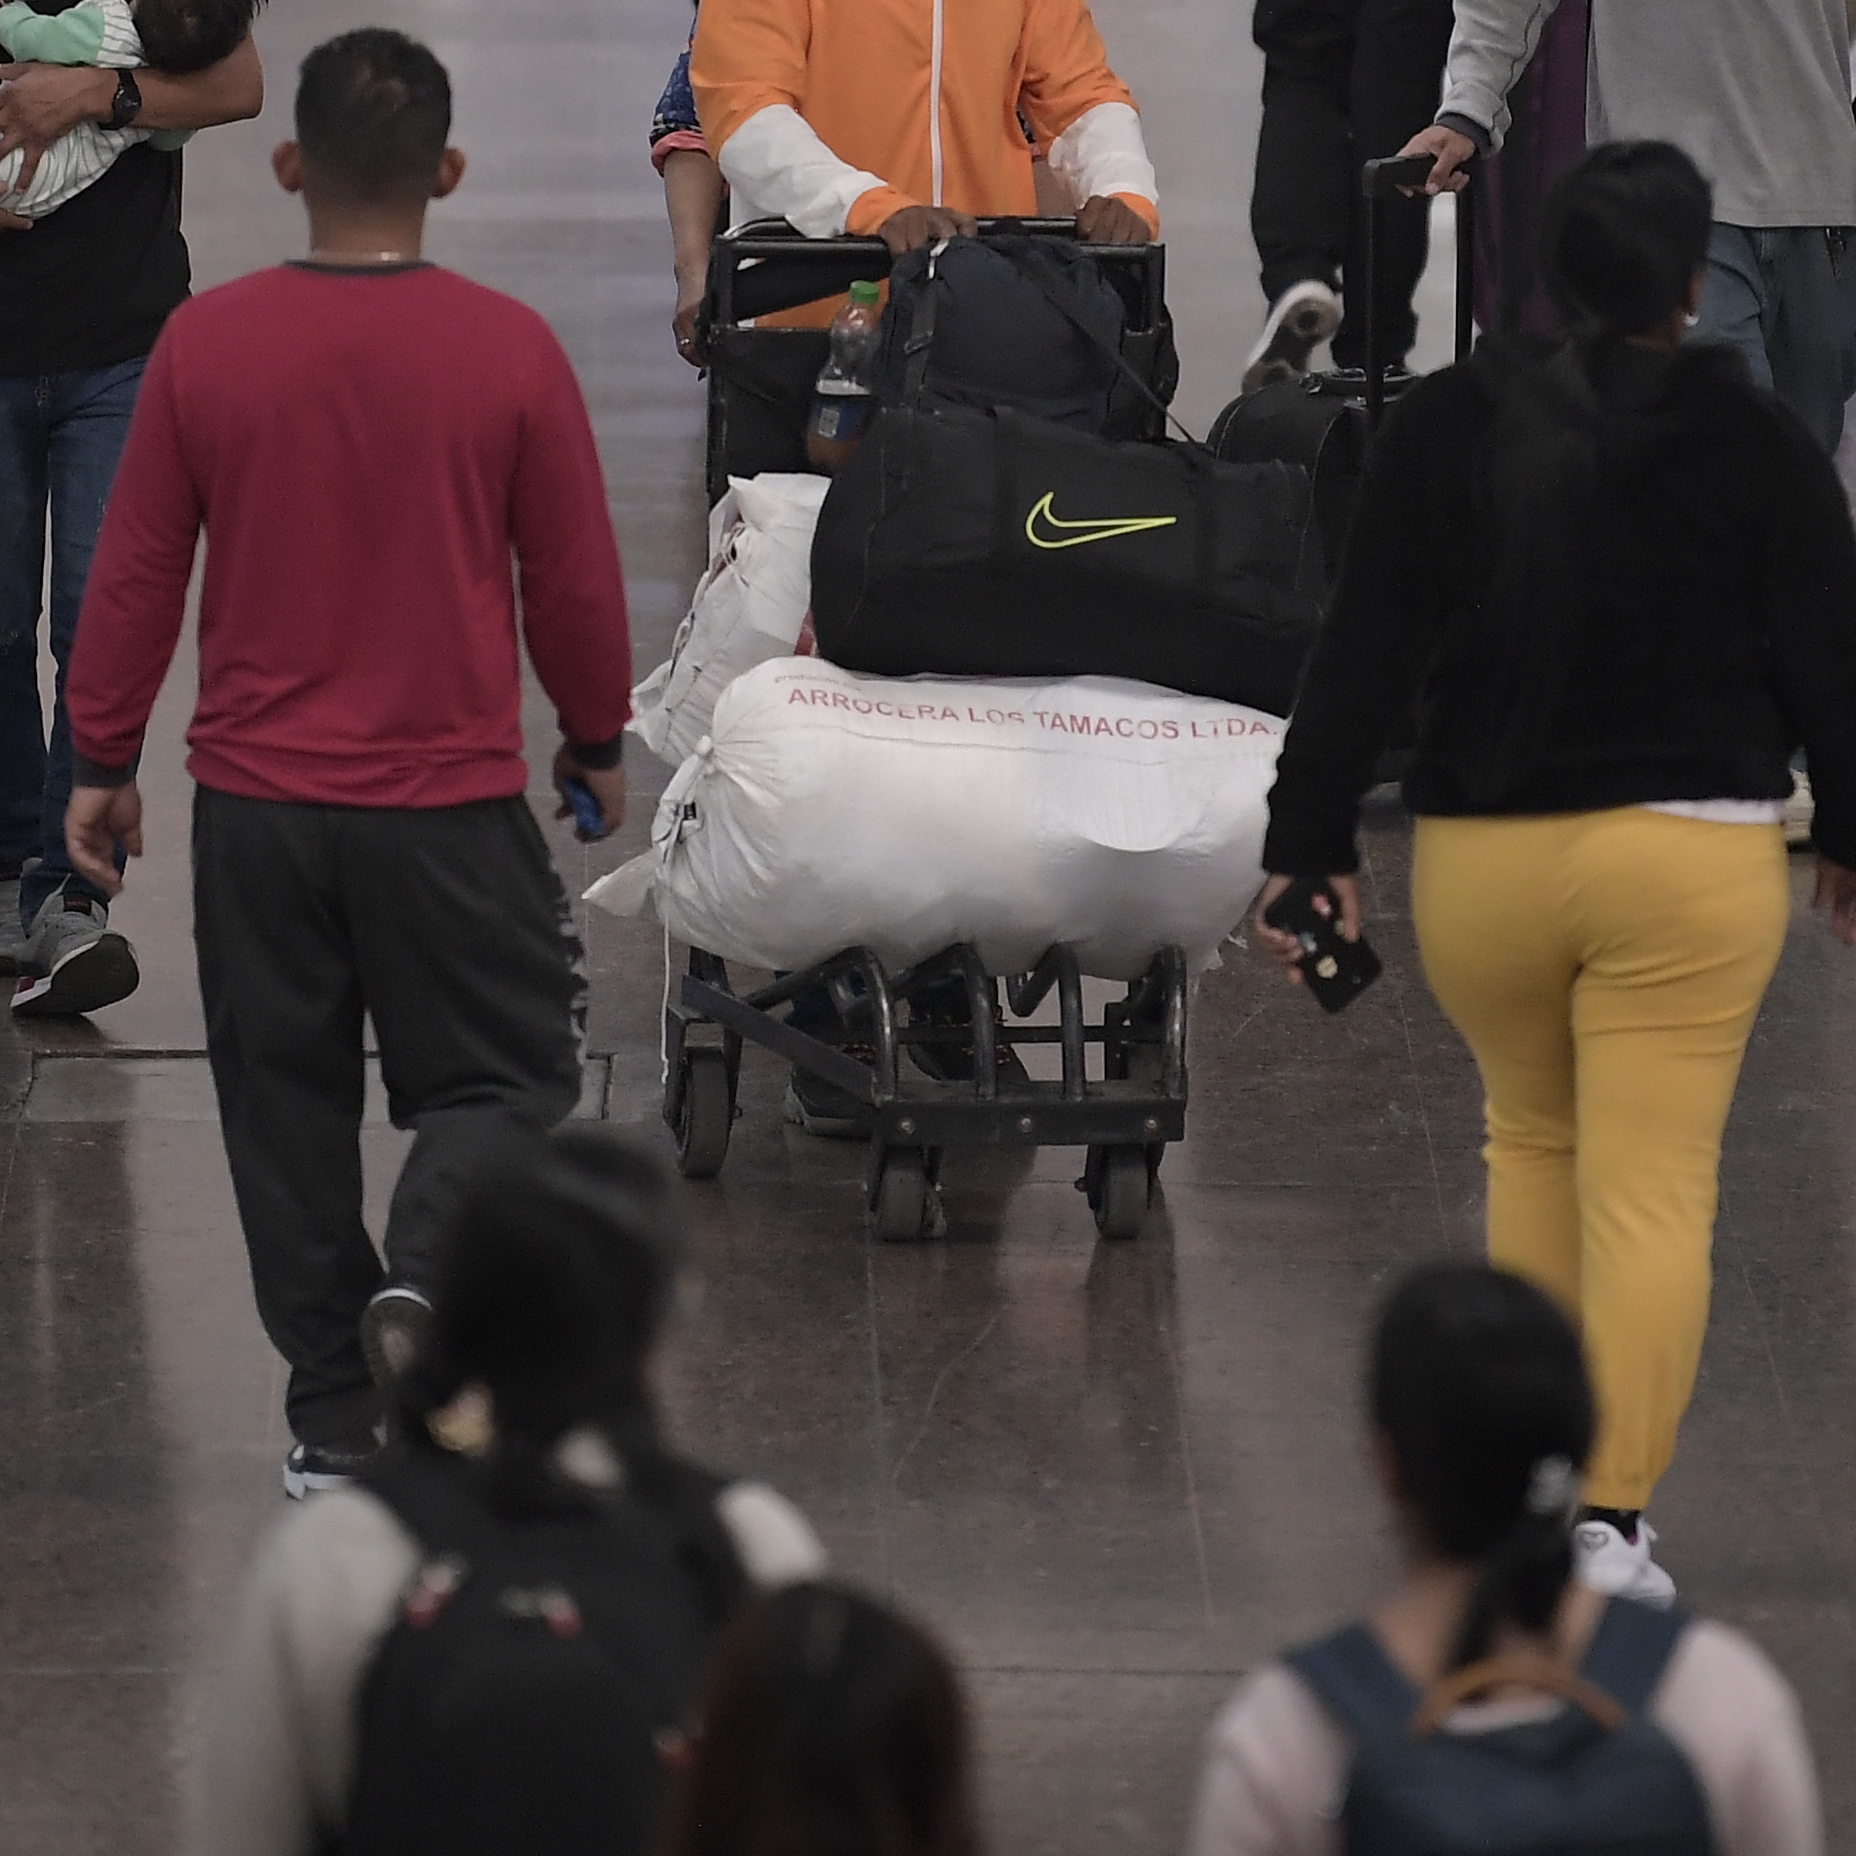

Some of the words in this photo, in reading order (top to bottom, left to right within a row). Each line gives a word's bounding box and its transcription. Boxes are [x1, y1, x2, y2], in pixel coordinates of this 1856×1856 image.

[788, 688, 959, 722] ARROCERA
[968, 707, 1025, 724] LOS
[1033, 711, 1179, 740] TAMACOS
[1190, 719, 1280, 740] LTDA.
